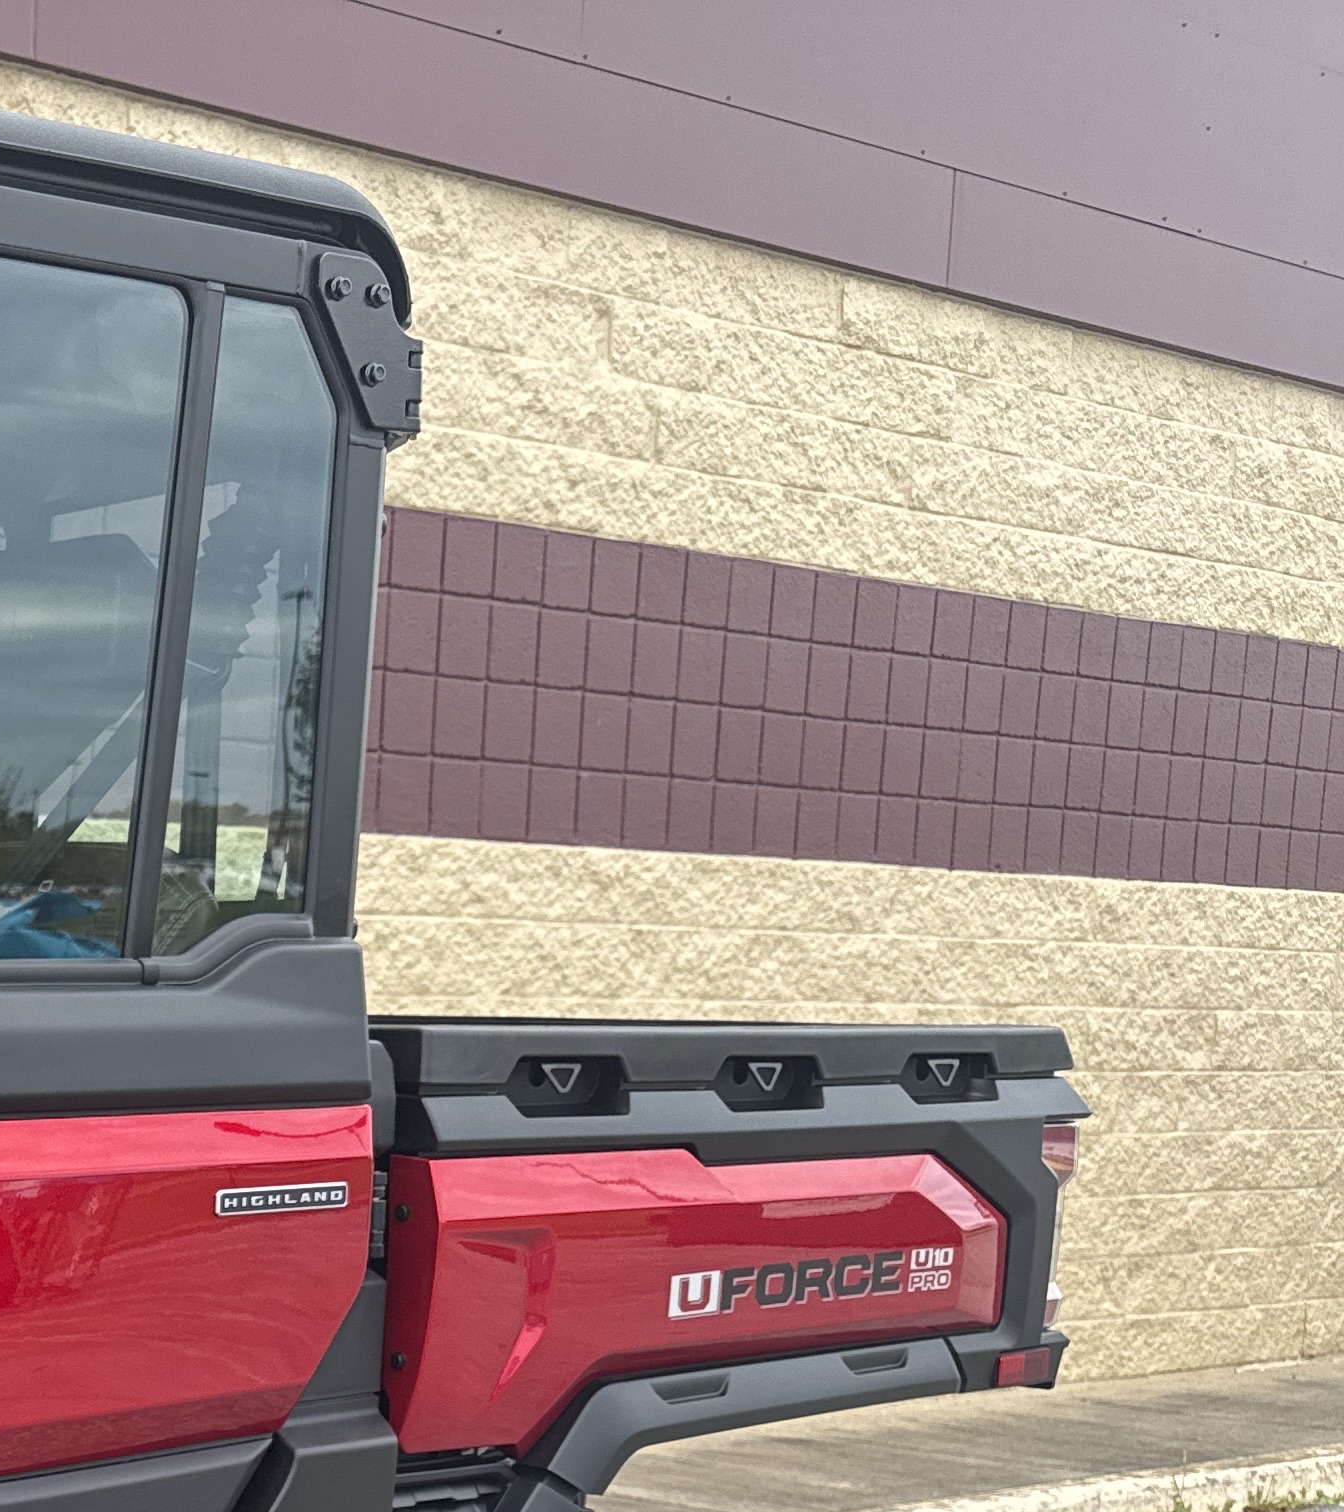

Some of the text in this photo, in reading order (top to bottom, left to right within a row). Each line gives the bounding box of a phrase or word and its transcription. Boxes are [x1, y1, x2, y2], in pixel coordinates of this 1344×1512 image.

[224, 1190, 343, 1208] HIGHLAND
[909, 1247, 954, 1270] U10
[908, 1269, 951, 1291] PRO
